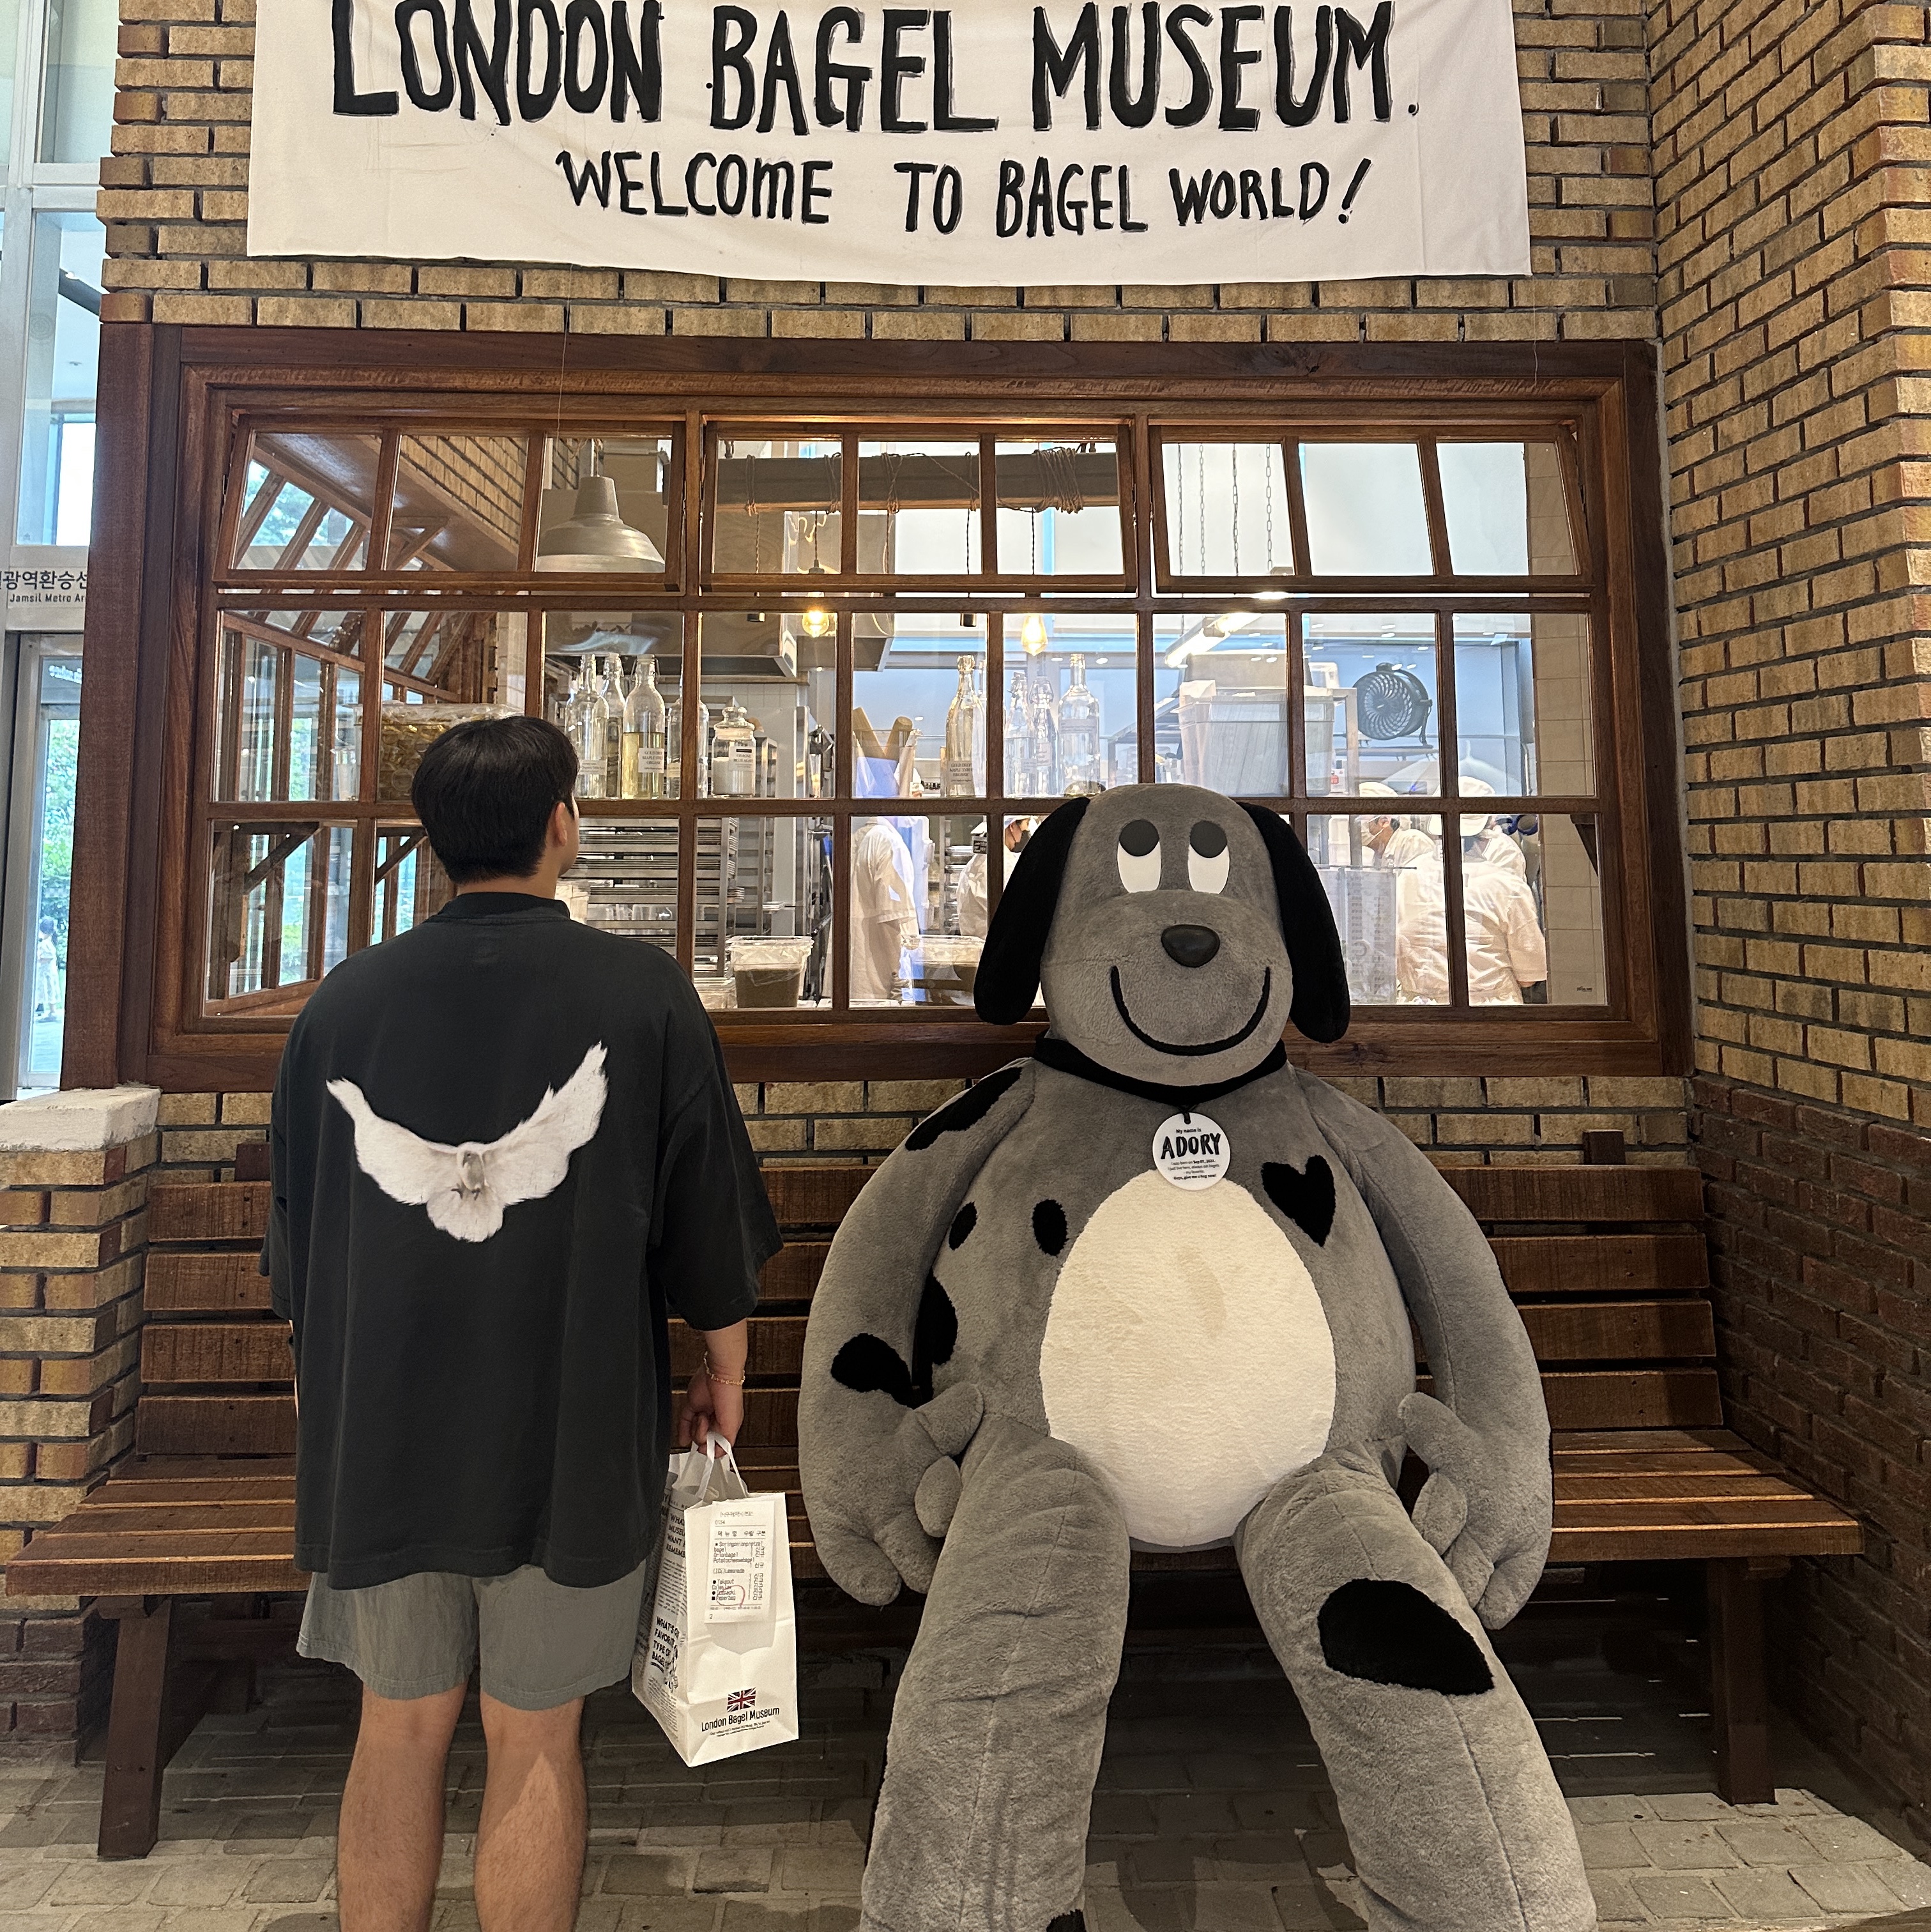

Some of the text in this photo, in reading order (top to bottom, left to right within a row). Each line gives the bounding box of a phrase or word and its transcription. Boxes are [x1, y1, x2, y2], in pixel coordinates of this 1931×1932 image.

[332, 0, 662, 125] LONDON
[710, 6, 998, 135] BAGEL
[894, 162, 963, 234] TO
[995, 156, 1149, 238] BAGEL
[10, 594, 42, 602] Jamsil
[45, 594, 72, 602] Metro
[1161, 1133, 1221, 1160] ADORY
[670, 1513, 685, 1526] WHA
[653, 1640, 666, 1654] TYPE
[701, 1717, 727, 1732] London
[728, 1710, 748, 1725] Bagel
[749, 1707, 780, 1721] Museum
